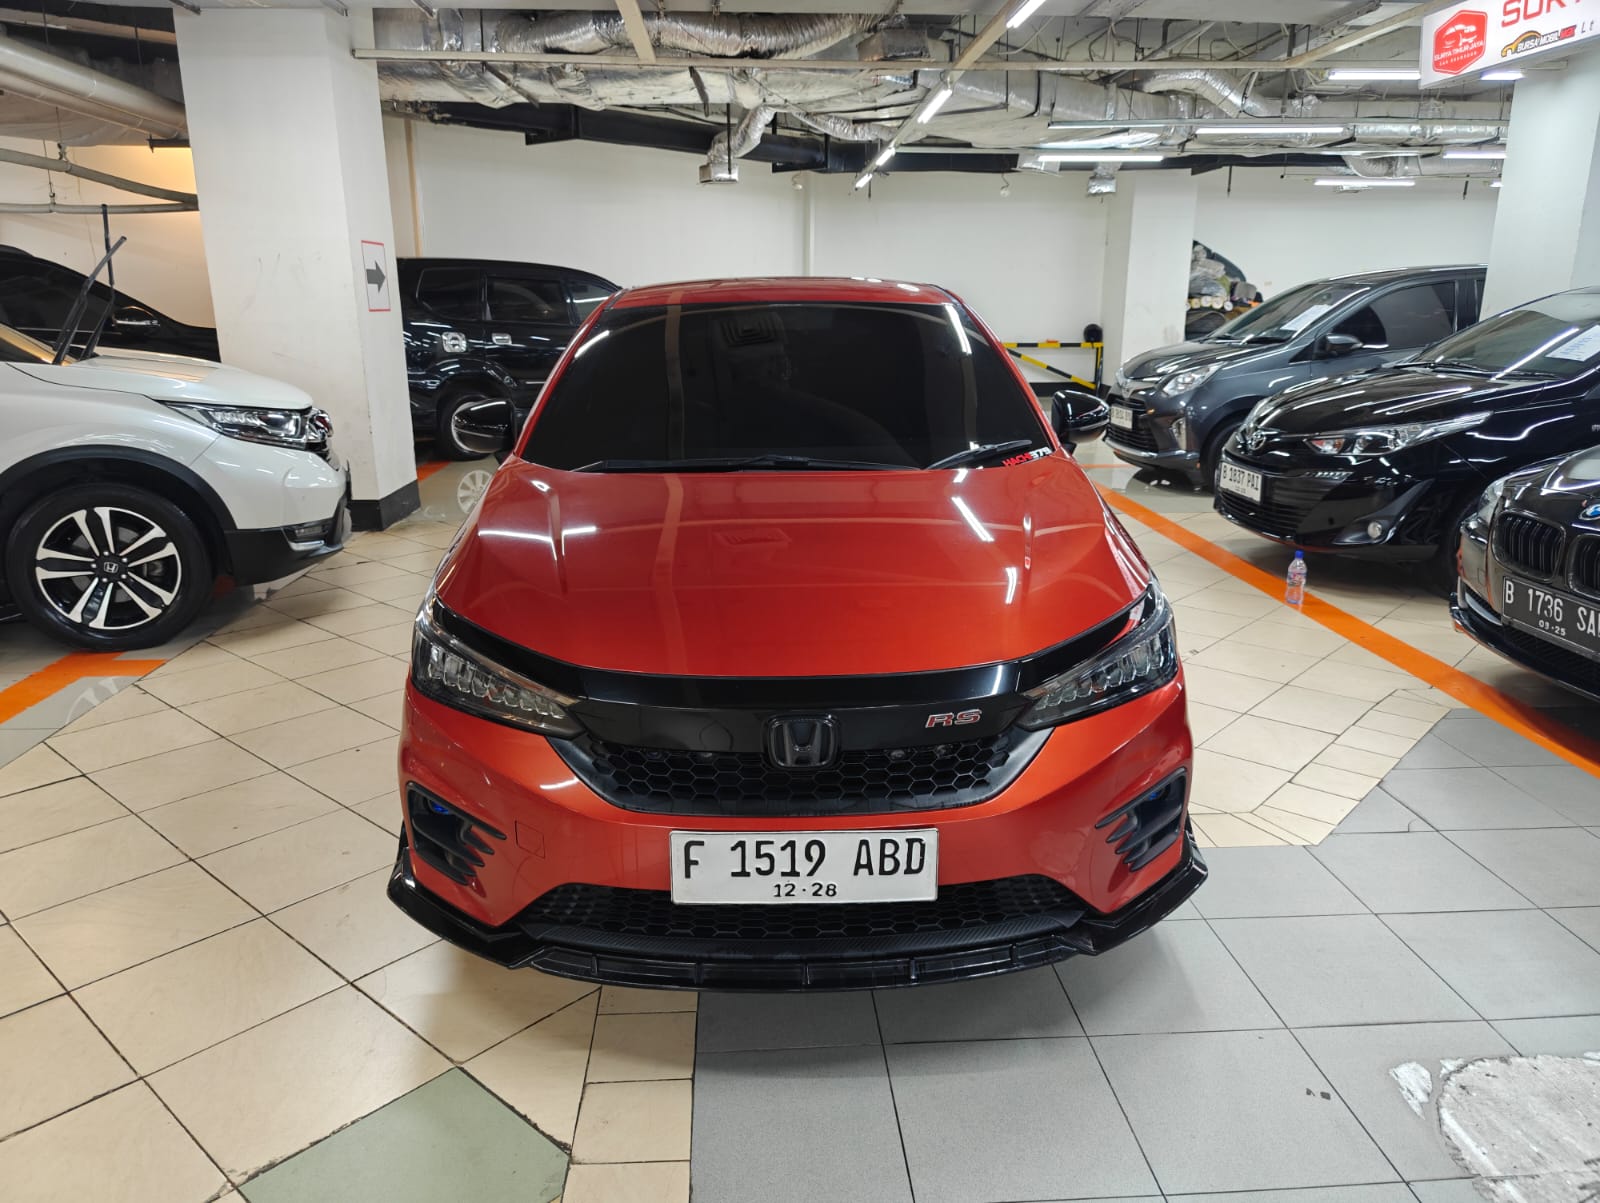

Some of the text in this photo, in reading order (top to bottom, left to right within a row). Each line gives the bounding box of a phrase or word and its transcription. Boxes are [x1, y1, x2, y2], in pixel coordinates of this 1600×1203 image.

[1505, 581, 1600, 638] B 1736 SA
[925, 708, 983, 728] RS
[683, 837, 926, 879] F 1519 ABD
